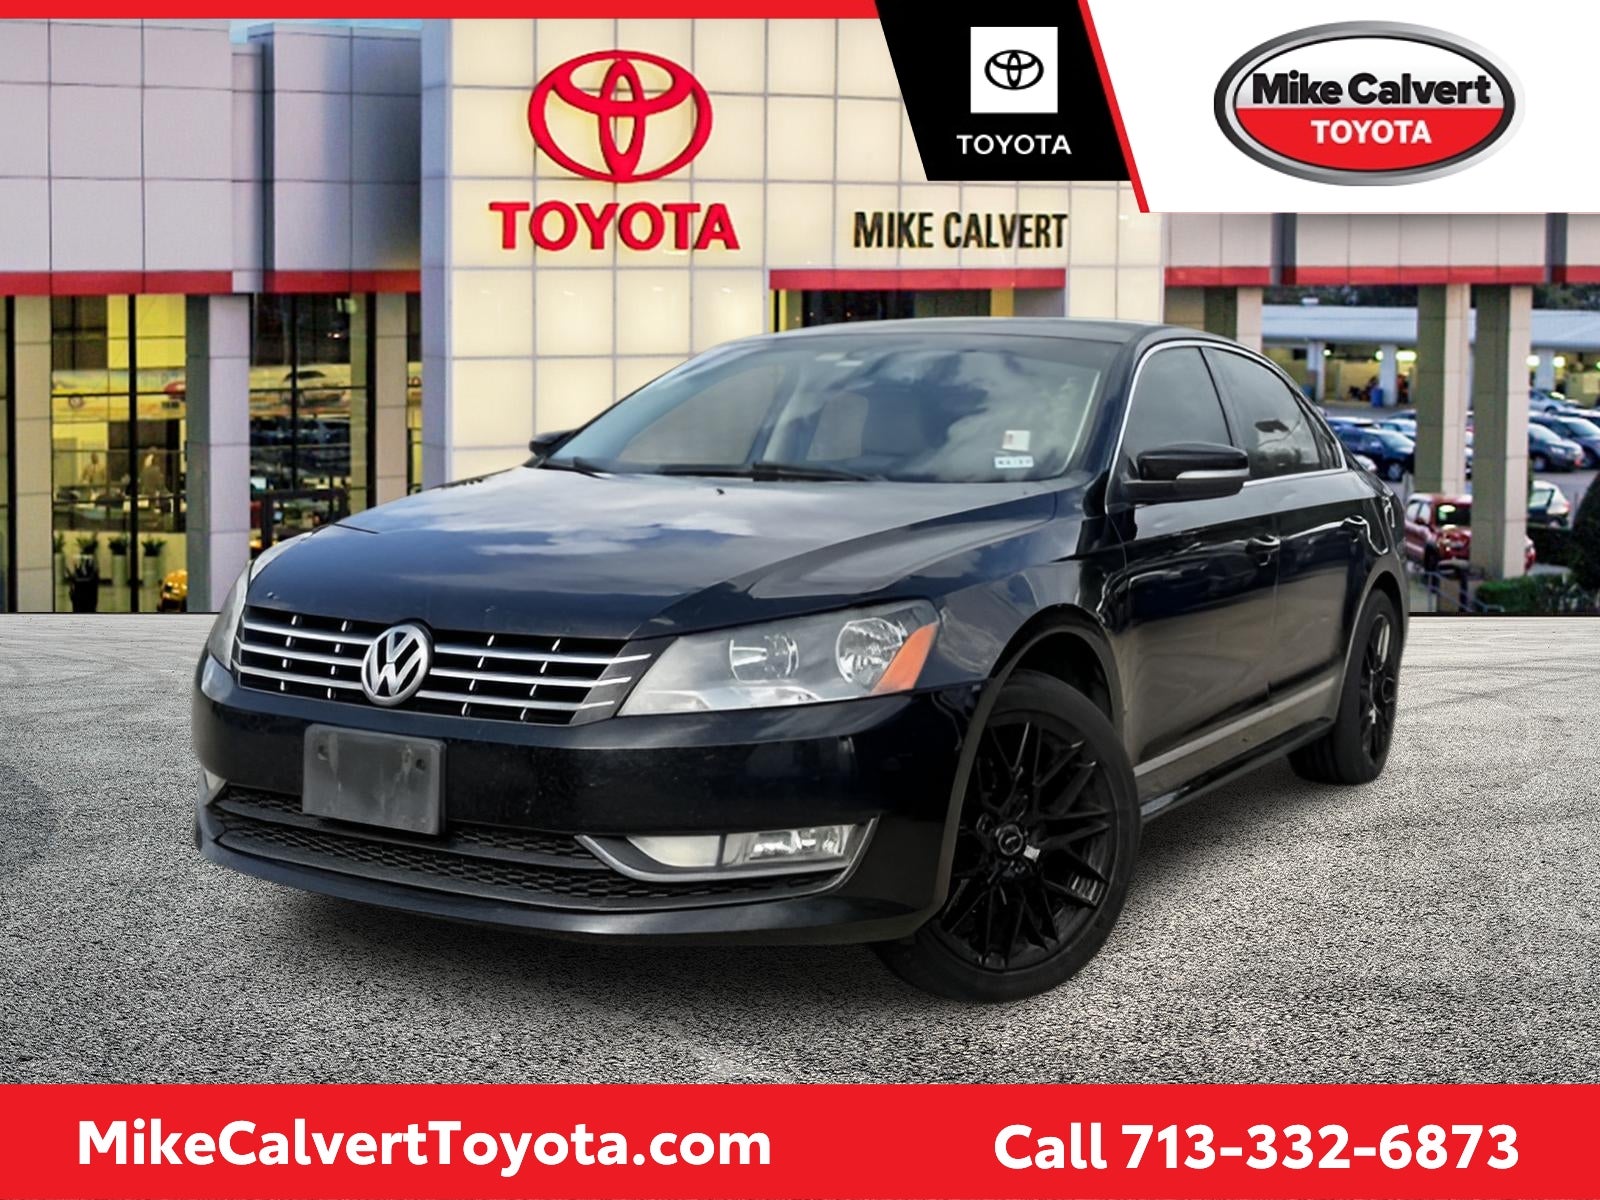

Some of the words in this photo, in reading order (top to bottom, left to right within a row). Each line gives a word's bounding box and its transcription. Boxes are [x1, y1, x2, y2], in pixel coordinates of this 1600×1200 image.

[489, 201, 739, 251] TOYOTA
[853, 211, 934, 249] MIKE
[944, 211, 1068, 249] CALVERT
